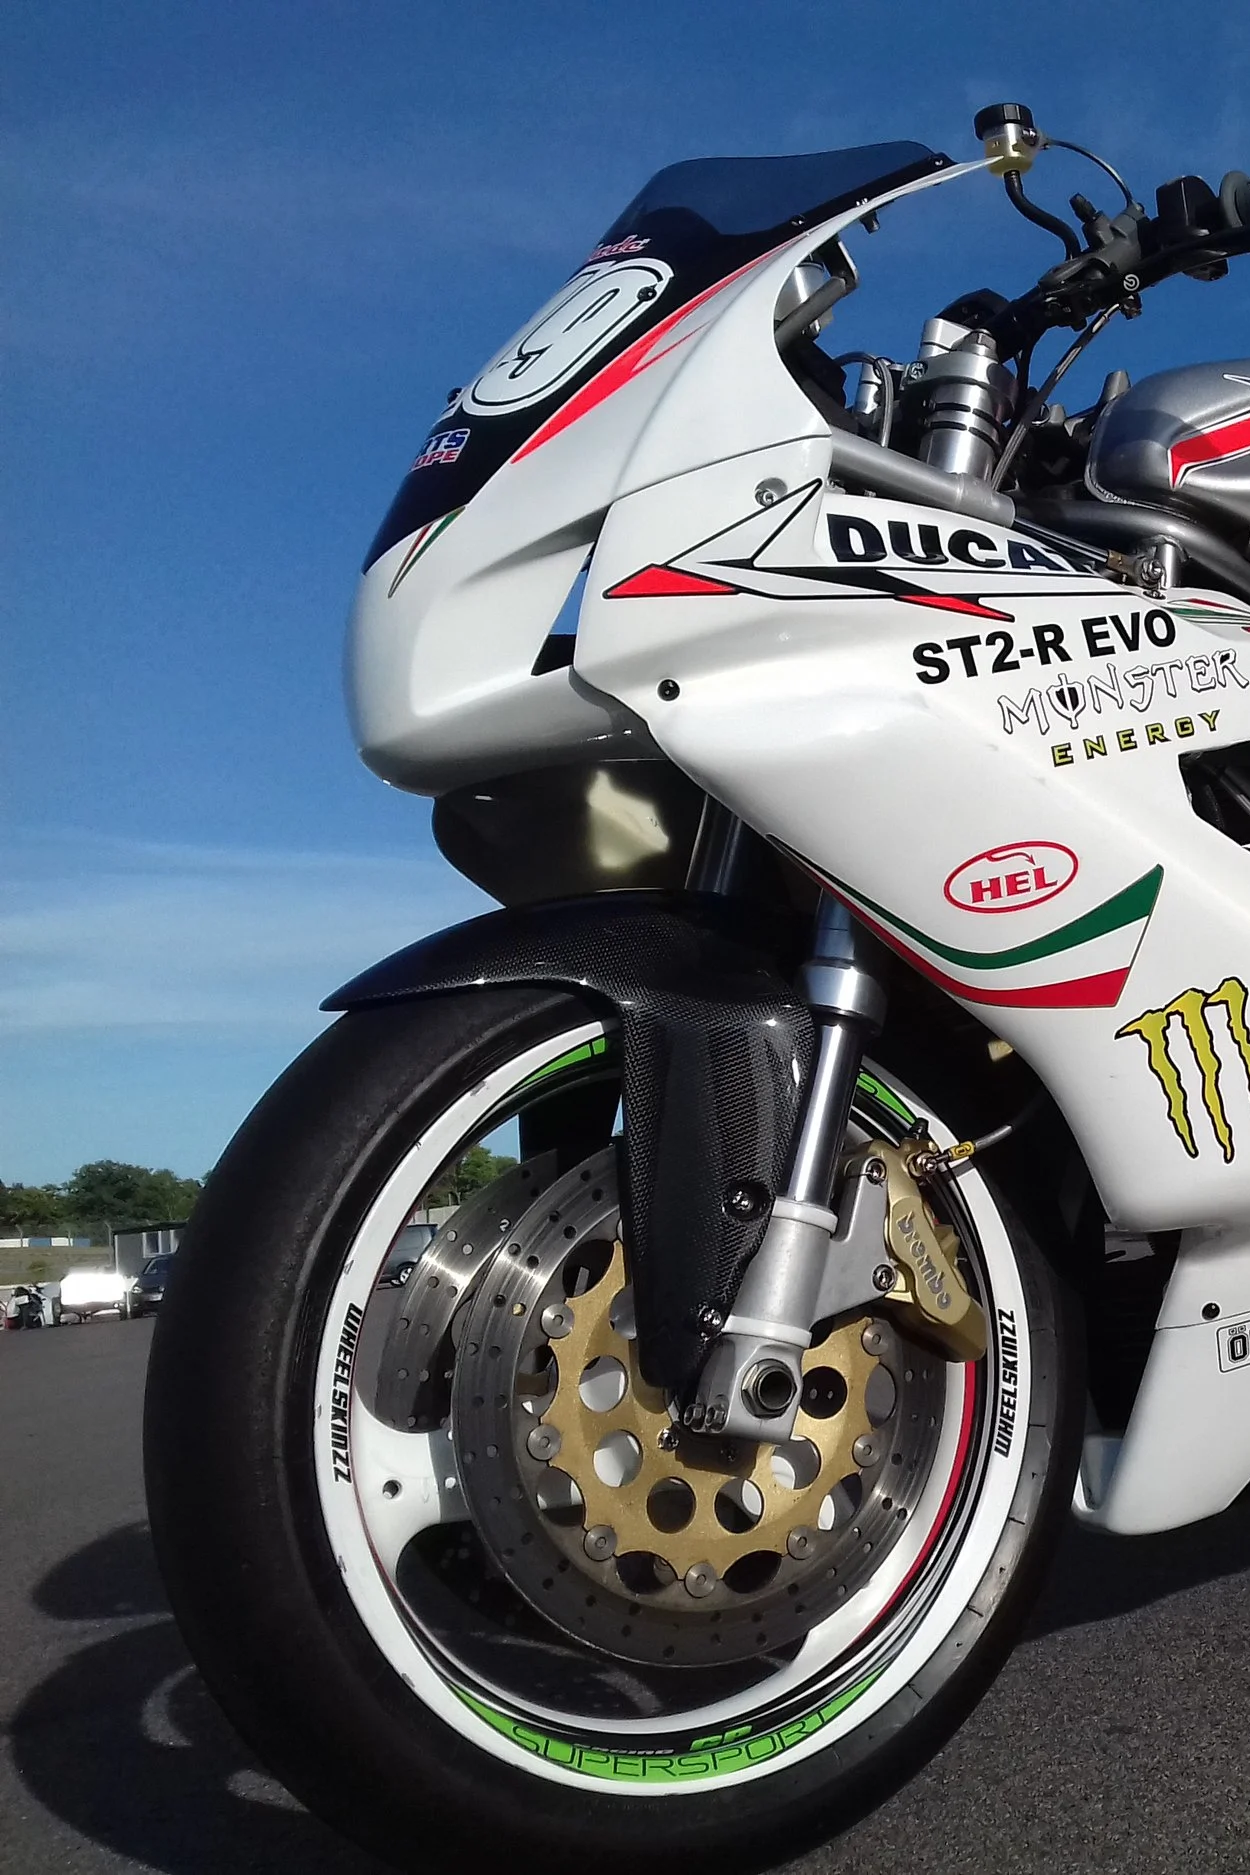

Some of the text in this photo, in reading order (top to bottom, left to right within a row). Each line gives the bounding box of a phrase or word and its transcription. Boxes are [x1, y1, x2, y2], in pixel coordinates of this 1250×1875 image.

[912, 608, 1177, 684] ST2-R EVO
[997, 648, 1250, 735] MONSTER
[1050, 708, 1221, 768] ENERGY
[969, 862, 1059, 904] HEL
[895, 1210, 952, 1310] brembo
[331, 1301, 363, 1484] WHEELSKINZZ
[994, 1308, 1017, 1458] WHEELSKINZZ
[511, 1706, 829, 1779] SUPERSPORT
